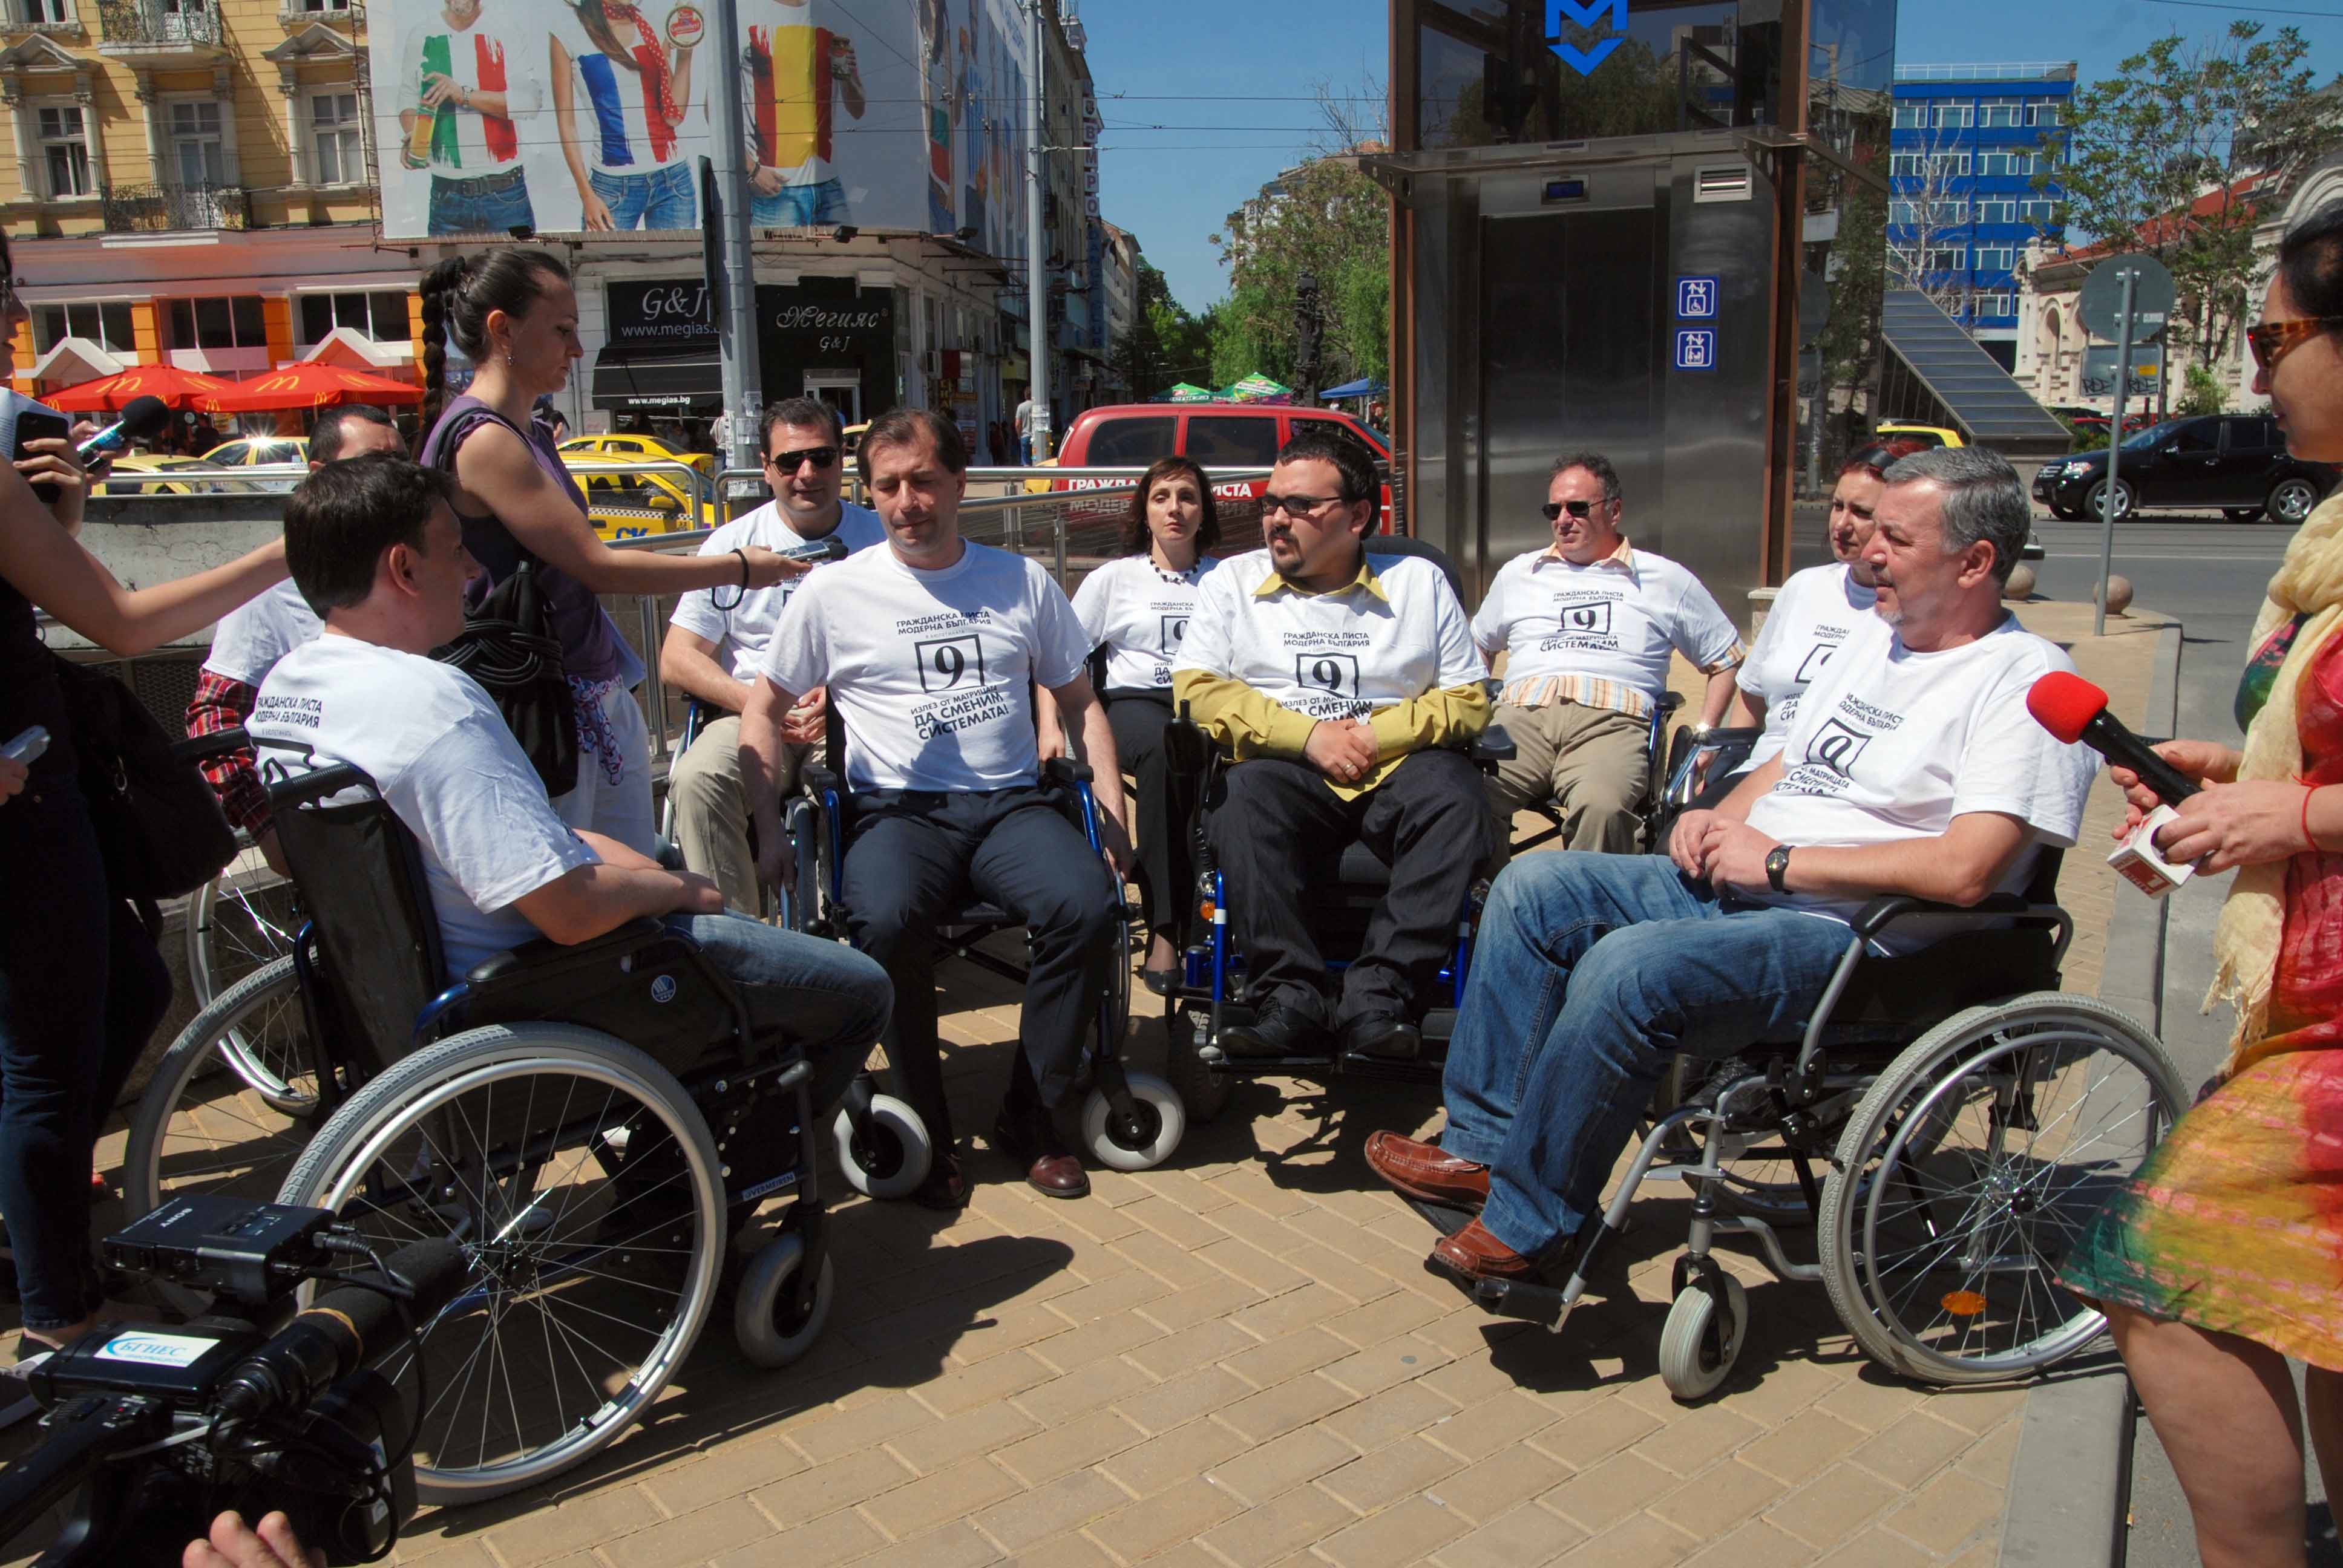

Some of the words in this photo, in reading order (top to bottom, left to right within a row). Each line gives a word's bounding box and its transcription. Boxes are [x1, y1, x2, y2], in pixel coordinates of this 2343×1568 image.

[621, 322, 721, 339] www.megias.
[628, 396, 690, 405] www.megias.bg
[896, 612, 958, 627] ГРАЖДАНСКА
[898, 623, 943, 635] МОДЕРНА
[946, 619, 992, 629] БЪЛГАРИЯ
[1573, 609, 1596, 630] 9
[1283, 631, 1340, 640] ГРАЖДАНСКА
[1283, 638, 1325, 647] МОДЕРНА
[934, 645, 965, 690] 9
[1155, 667, 1170, 676] ДА
[1312, 659, 1342, 690] 9
[297, 698, 323, 713] ЛИСТА
[911, 702, 938, 715] ИЗЛЕЗ
[940, 698, 951, 707] ОТ
[953, 685, 997, 704] МАТРИЦАТА
[1282, 699, 1308, 708] ИЗЛЕЗ
[1782, 701, 1798, 711] ДА
[914, 712, 938, 729] ДА
[940, 693, 1004, 719] СМЕНИМ
[1308, 700, 1373, 717] СМЕНИМ
[280, 712, 320, 728] БЪЛГАРИЯ
[919, 704, 1009, 740] СИСТЕМАТА!
[1809, 767, 1850, 788] МАТРИЦАТА
[120, 1342, 186, 1357] БГНЕС
